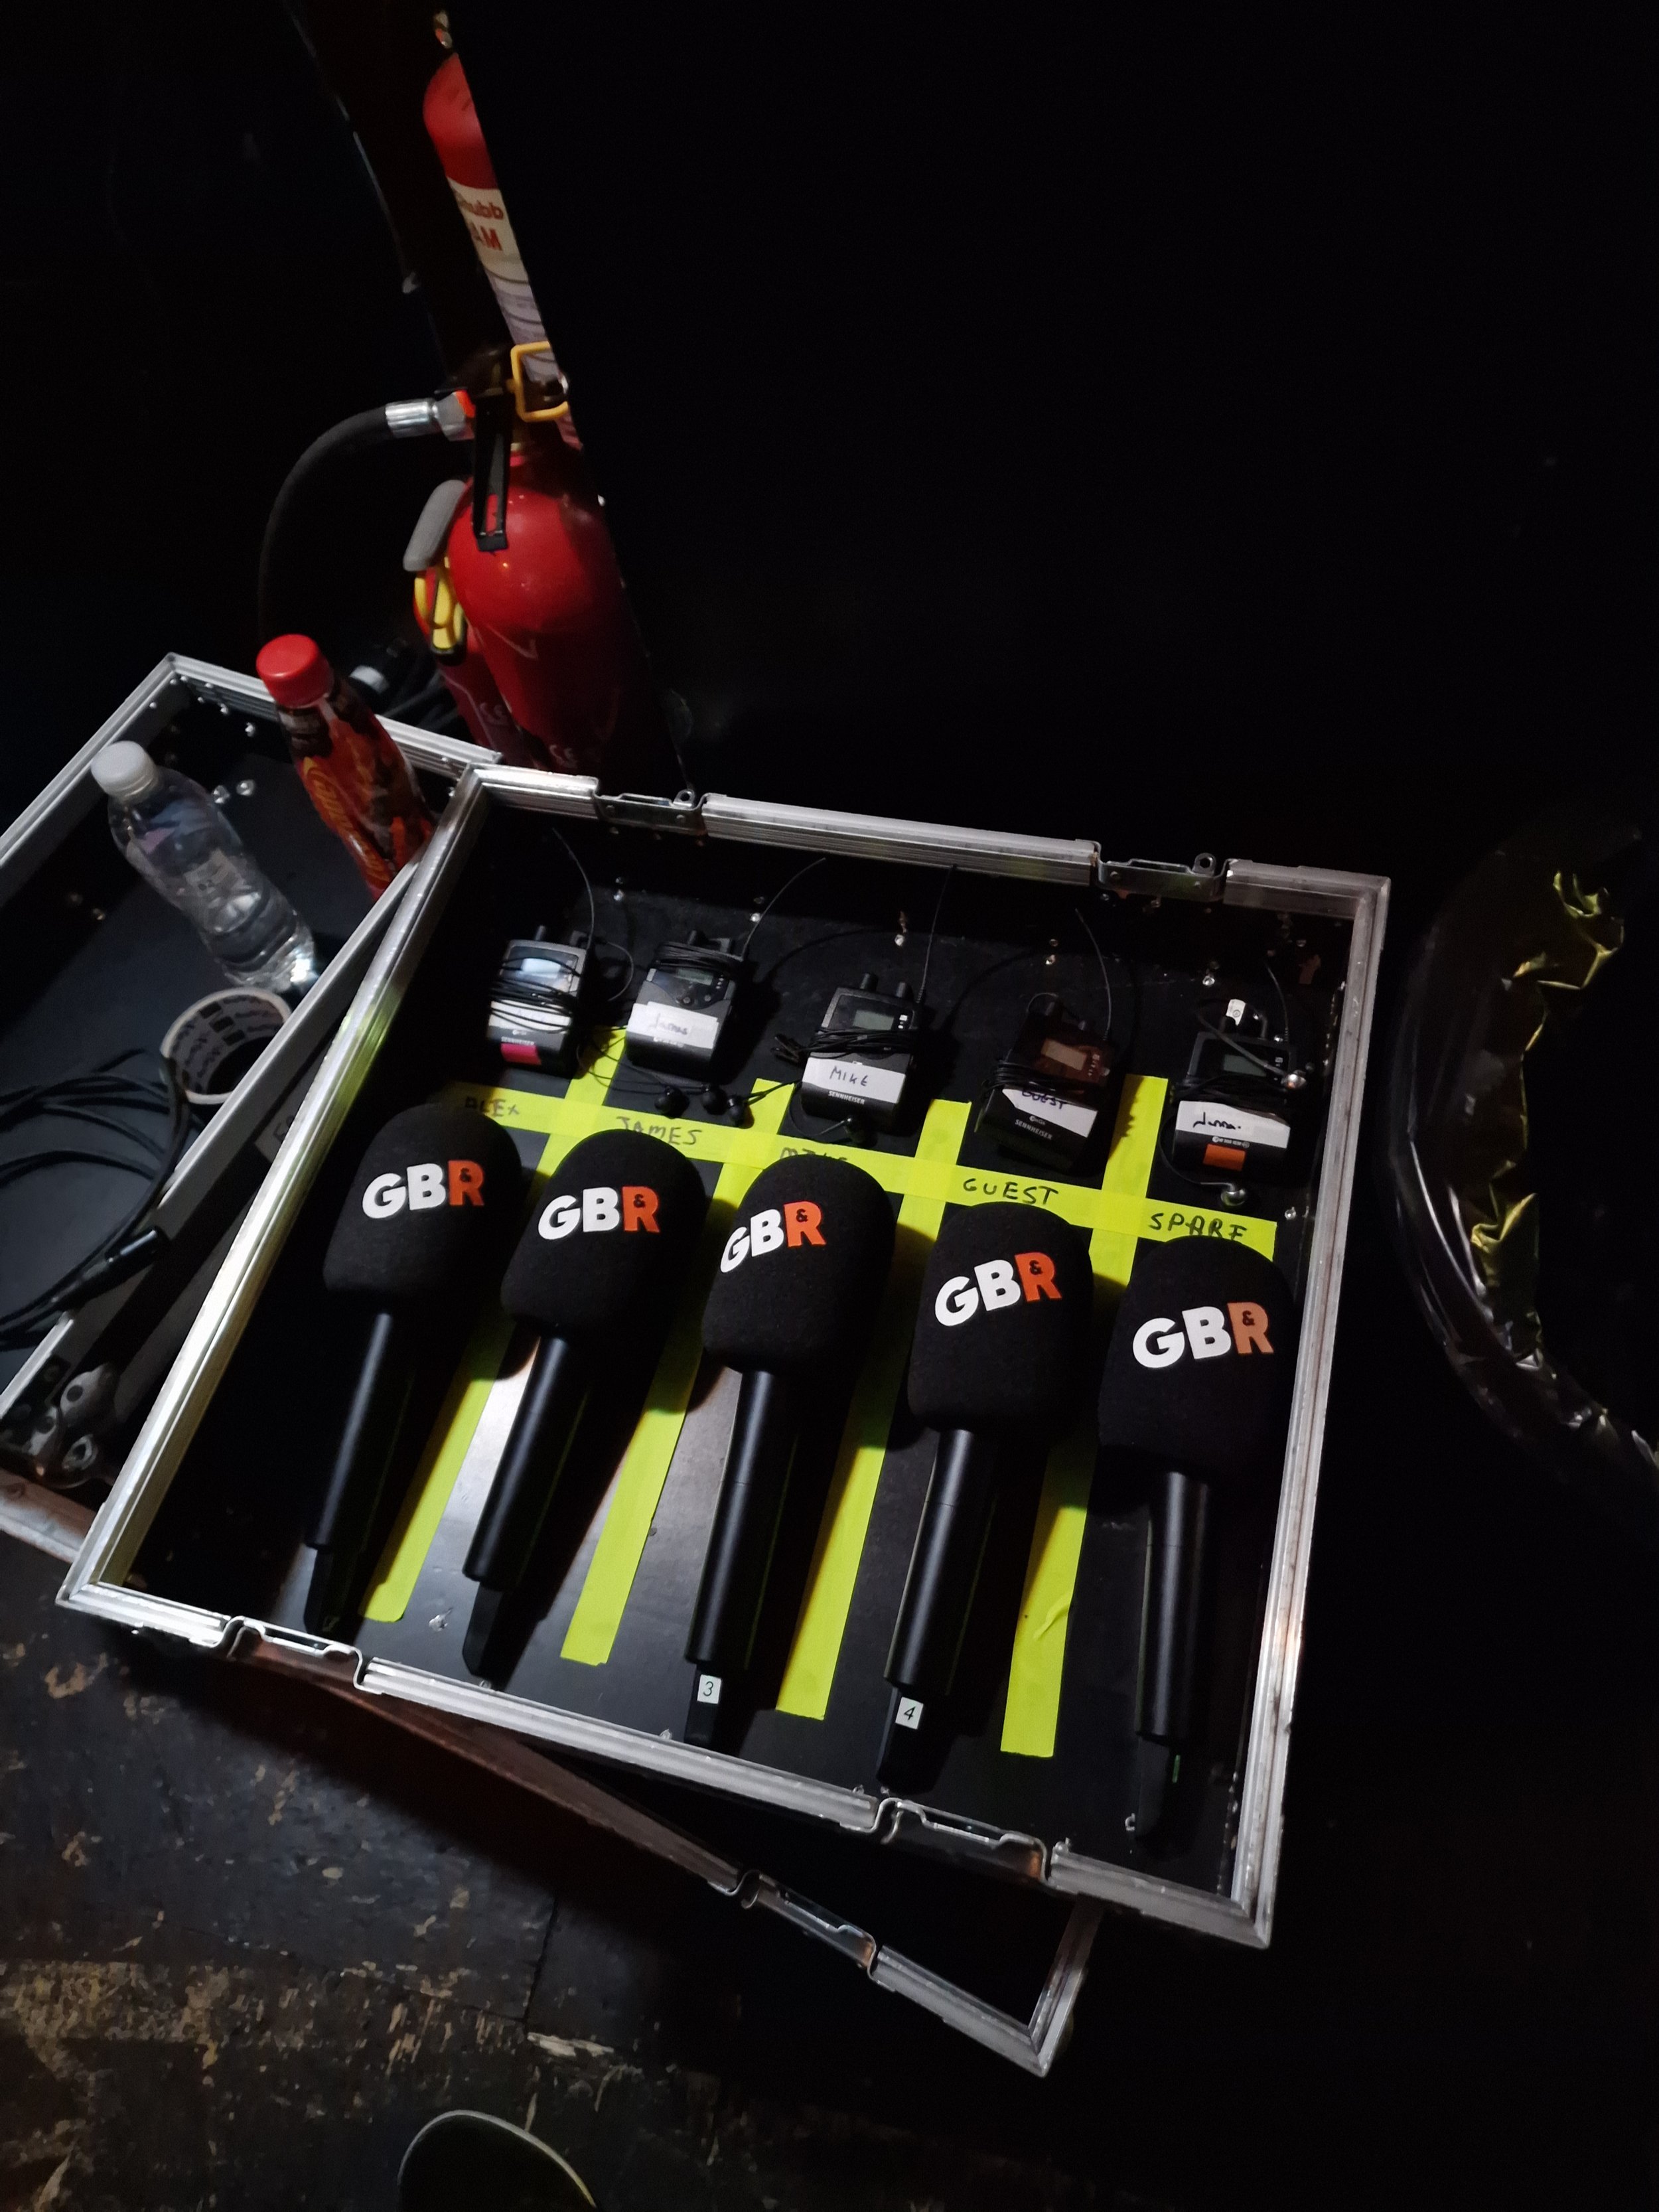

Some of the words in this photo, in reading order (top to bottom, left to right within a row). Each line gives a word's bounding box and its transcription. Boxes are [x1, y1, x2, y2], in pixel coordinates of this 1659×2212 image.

[830, 1065, 868, 1086] MIKE
[828, 1090, 865, 1105] SENNHEISER
[616, 1116, 702, 1145] JAMES
[1015, 1119, 1053, 1140] SENNHEISER
[963, 1178, 1058, 1205] GUEST
[703, 1681, 713, 1696] 3
[904, 1706, 916, 1720] 4
